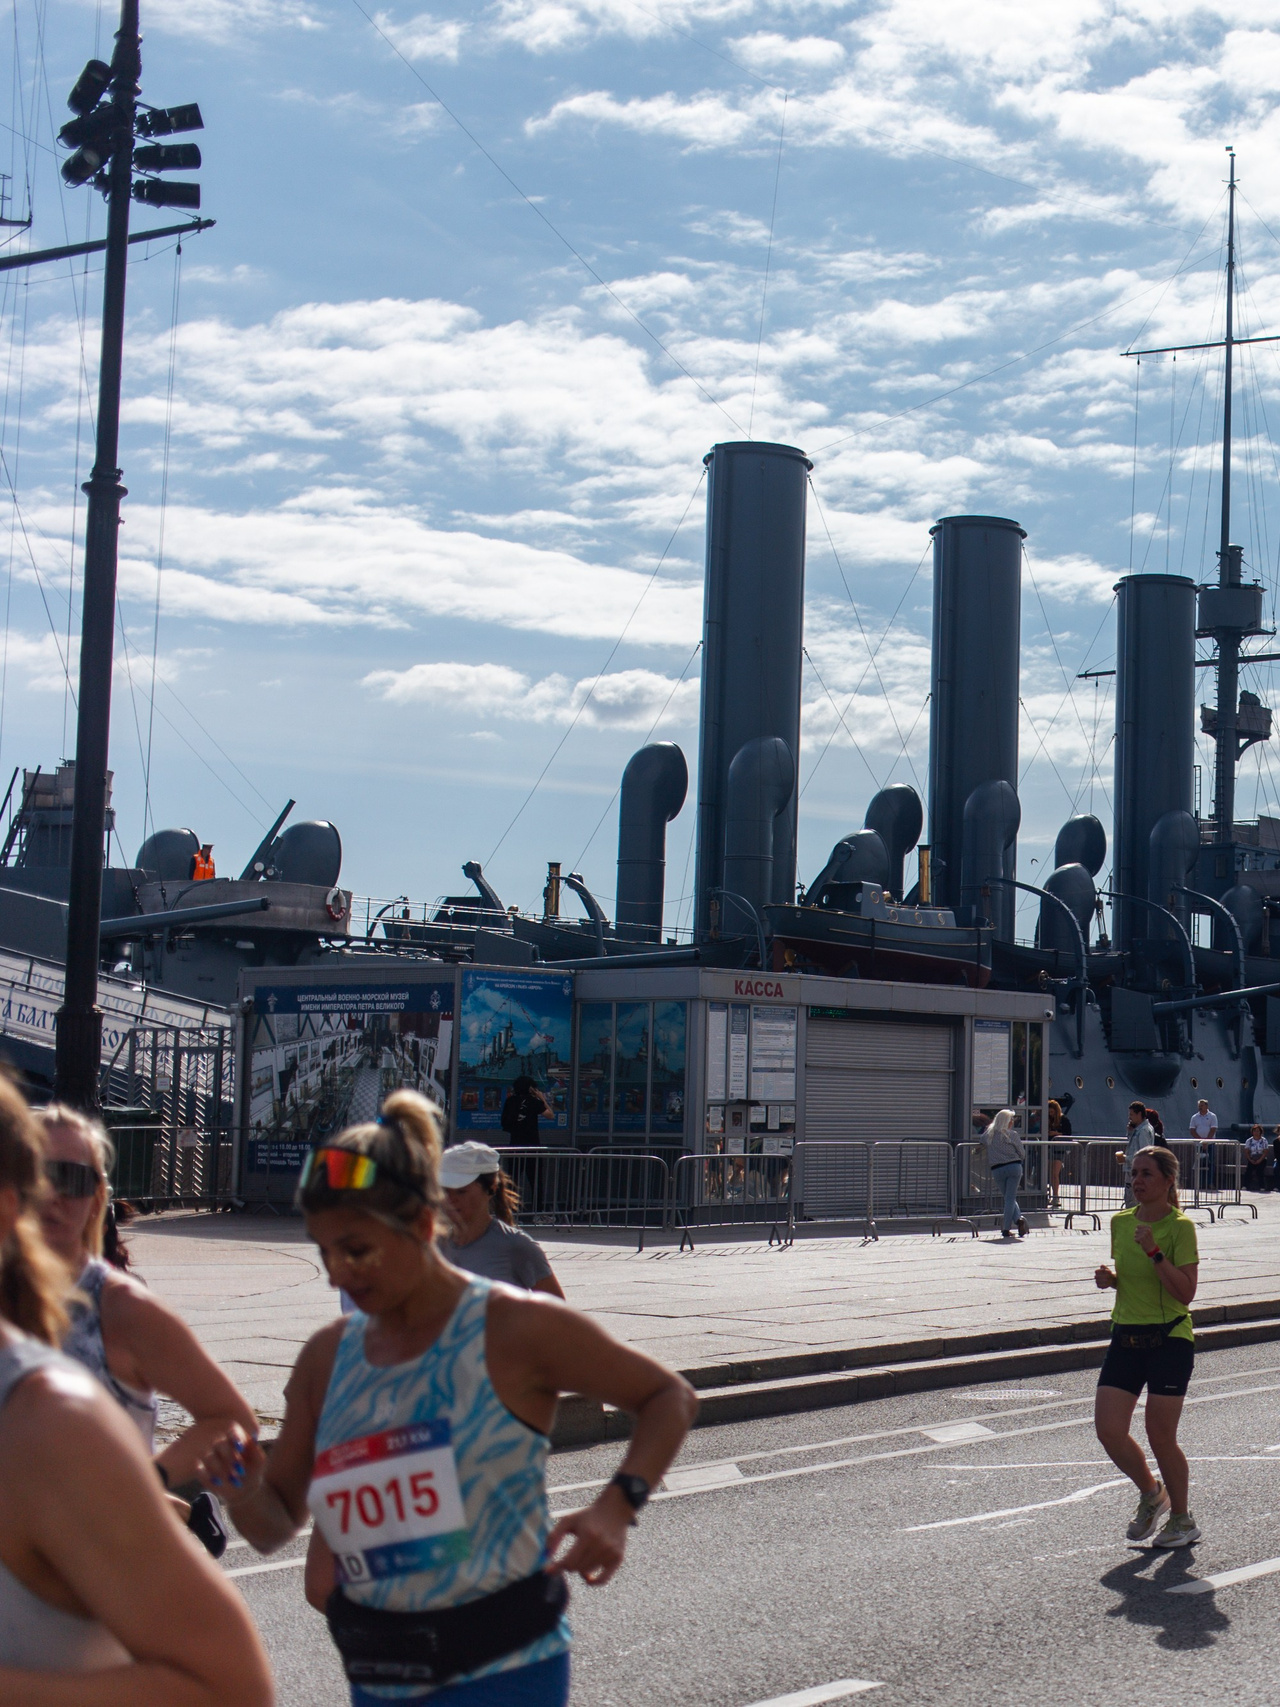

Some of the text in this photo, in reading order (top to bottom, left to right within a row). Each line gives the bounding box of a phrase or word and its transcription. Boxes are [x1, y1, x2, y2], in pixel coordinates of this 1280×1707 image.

[297, 991, 410, 1002] ЦЕНТРАЛЬНЫЙ ВОЕННО-МОРСКОЙ МУЗЕЙ
[734, 980, 784, 998] КАССА
[301, 1003, 320, 1011] ИМЕНИ
[376, 1002, 405, 1010] ВЕЛИКОГО
[325, 1470, 440, 1535] 7015
[346, 1555, 364, 1577] D
